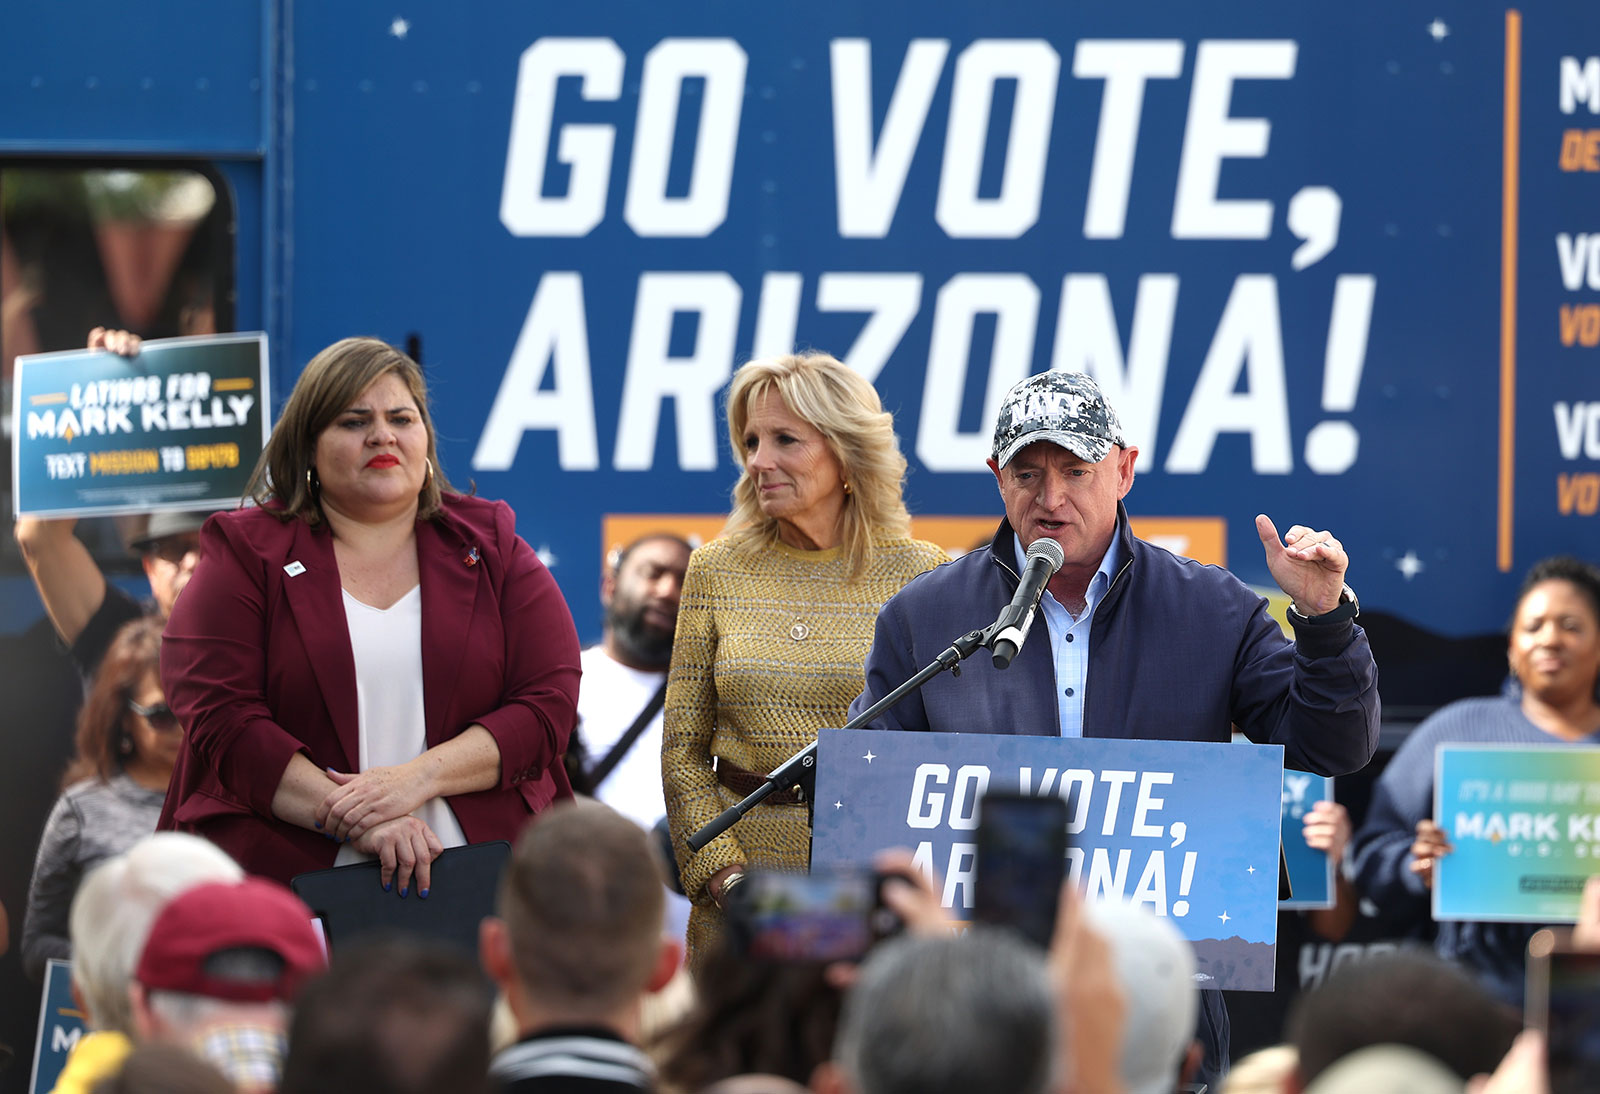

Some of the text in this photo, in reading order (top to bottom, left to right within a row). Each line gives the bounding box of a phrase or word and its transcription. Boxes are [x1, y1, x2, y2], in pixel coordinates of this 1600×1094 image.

[498, 37, 1342, 271] GO VOTE,
[1558, 129, 1600, 172] DE
[1559, 303, 1600, 347] VO
[69, 371, 211, 410] LATINOS FOR
[1011, 391, 1086, 427] NAVY
[26, 394, 255, 440] MARK KELLY
[45, 452, 87, 480] TEXT
[1556, 472, 1600, 516] VO
[905, 763, 991, 831] GO
[1454, 811, 1560, 843] MARK
